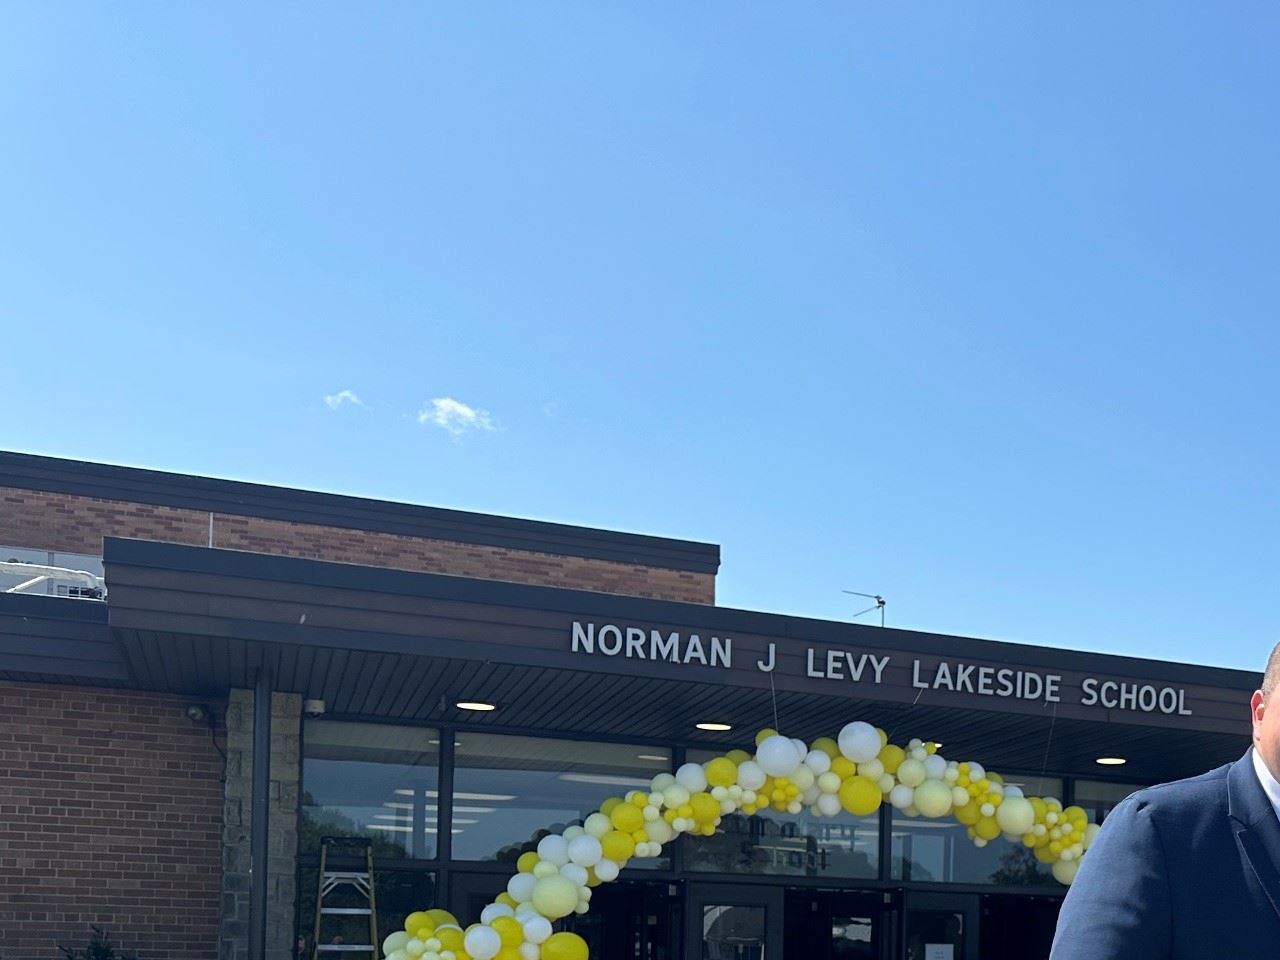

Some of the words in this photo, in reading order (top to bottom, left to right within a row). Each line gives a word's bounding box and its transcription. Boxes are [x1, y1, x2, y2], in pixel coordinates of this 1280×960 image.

[571, 621, 733, 669] NORMAN
[757, 643, 776, 673] J
[807, 647, 890, 685] LEVY
[912, 659, 1061, 703] LAKESIDE
[1081, 678, 1193, 715] SCHOOL
